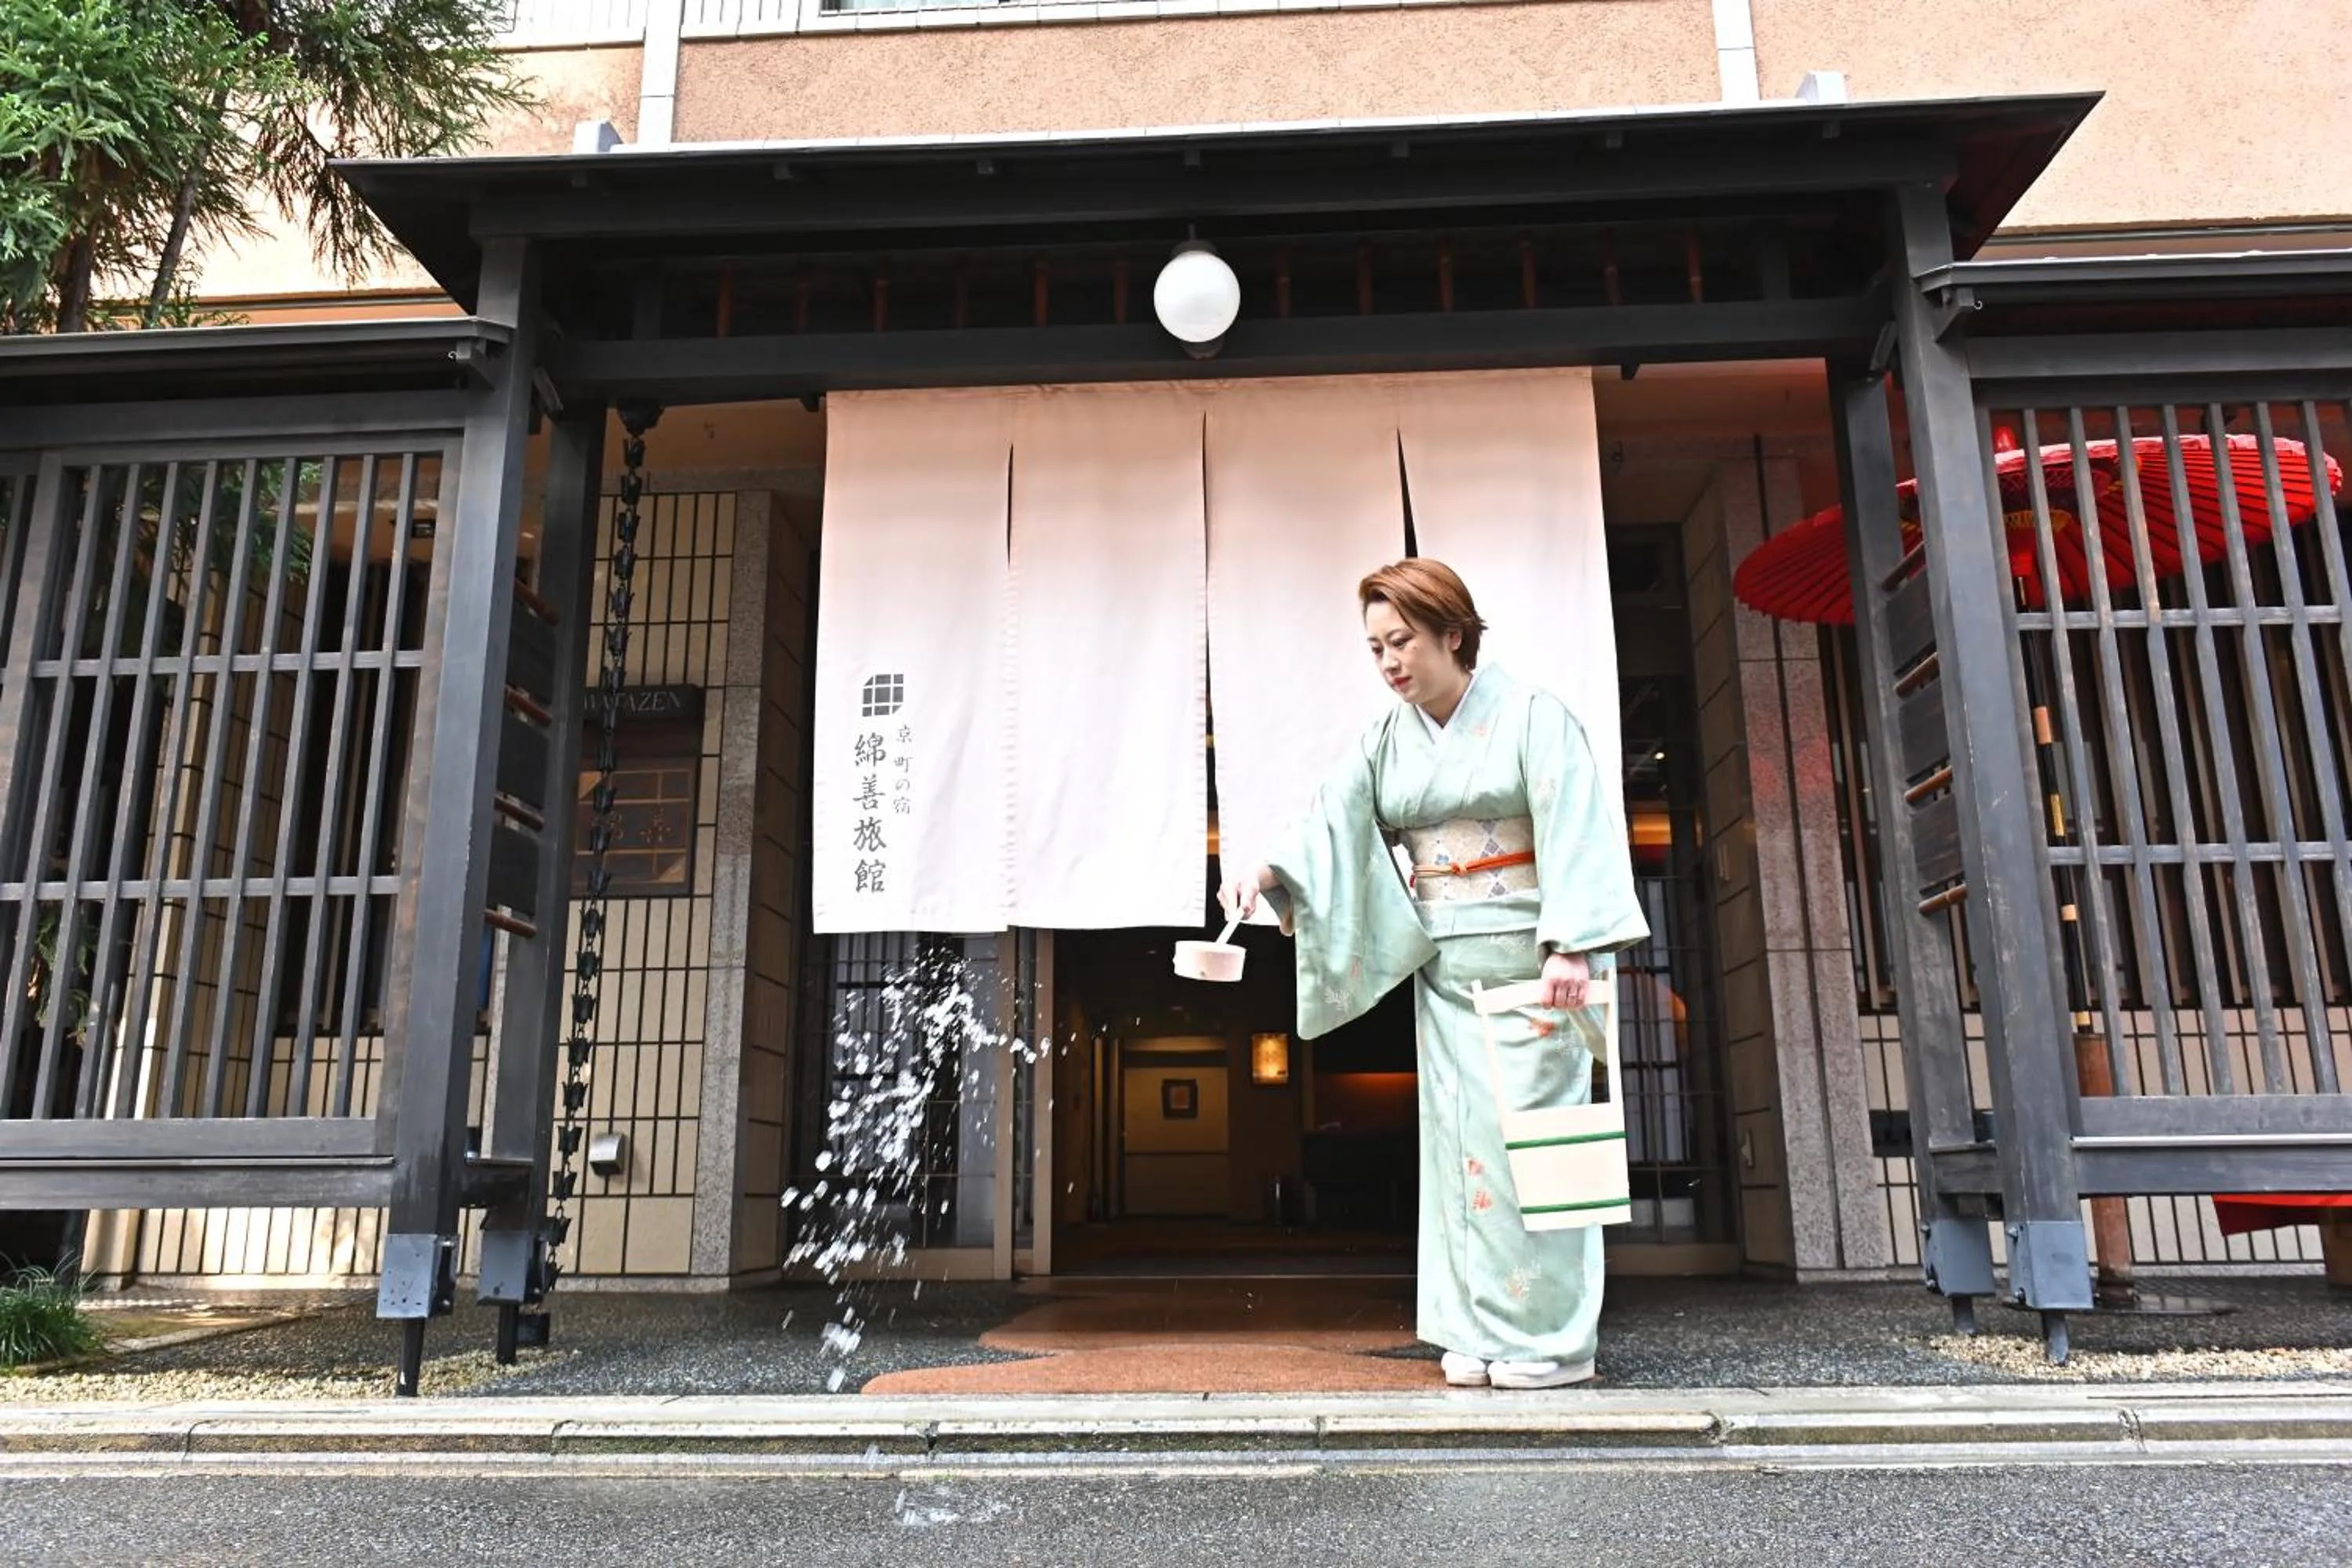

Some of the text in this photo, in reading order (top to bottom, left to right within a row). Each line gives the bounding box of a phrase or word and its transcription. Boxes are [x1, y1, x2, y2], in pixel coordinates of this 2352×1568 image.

[853, 732, 887, 894] 綿善旅館
[893, 724, 913, 815] 京町の宿
